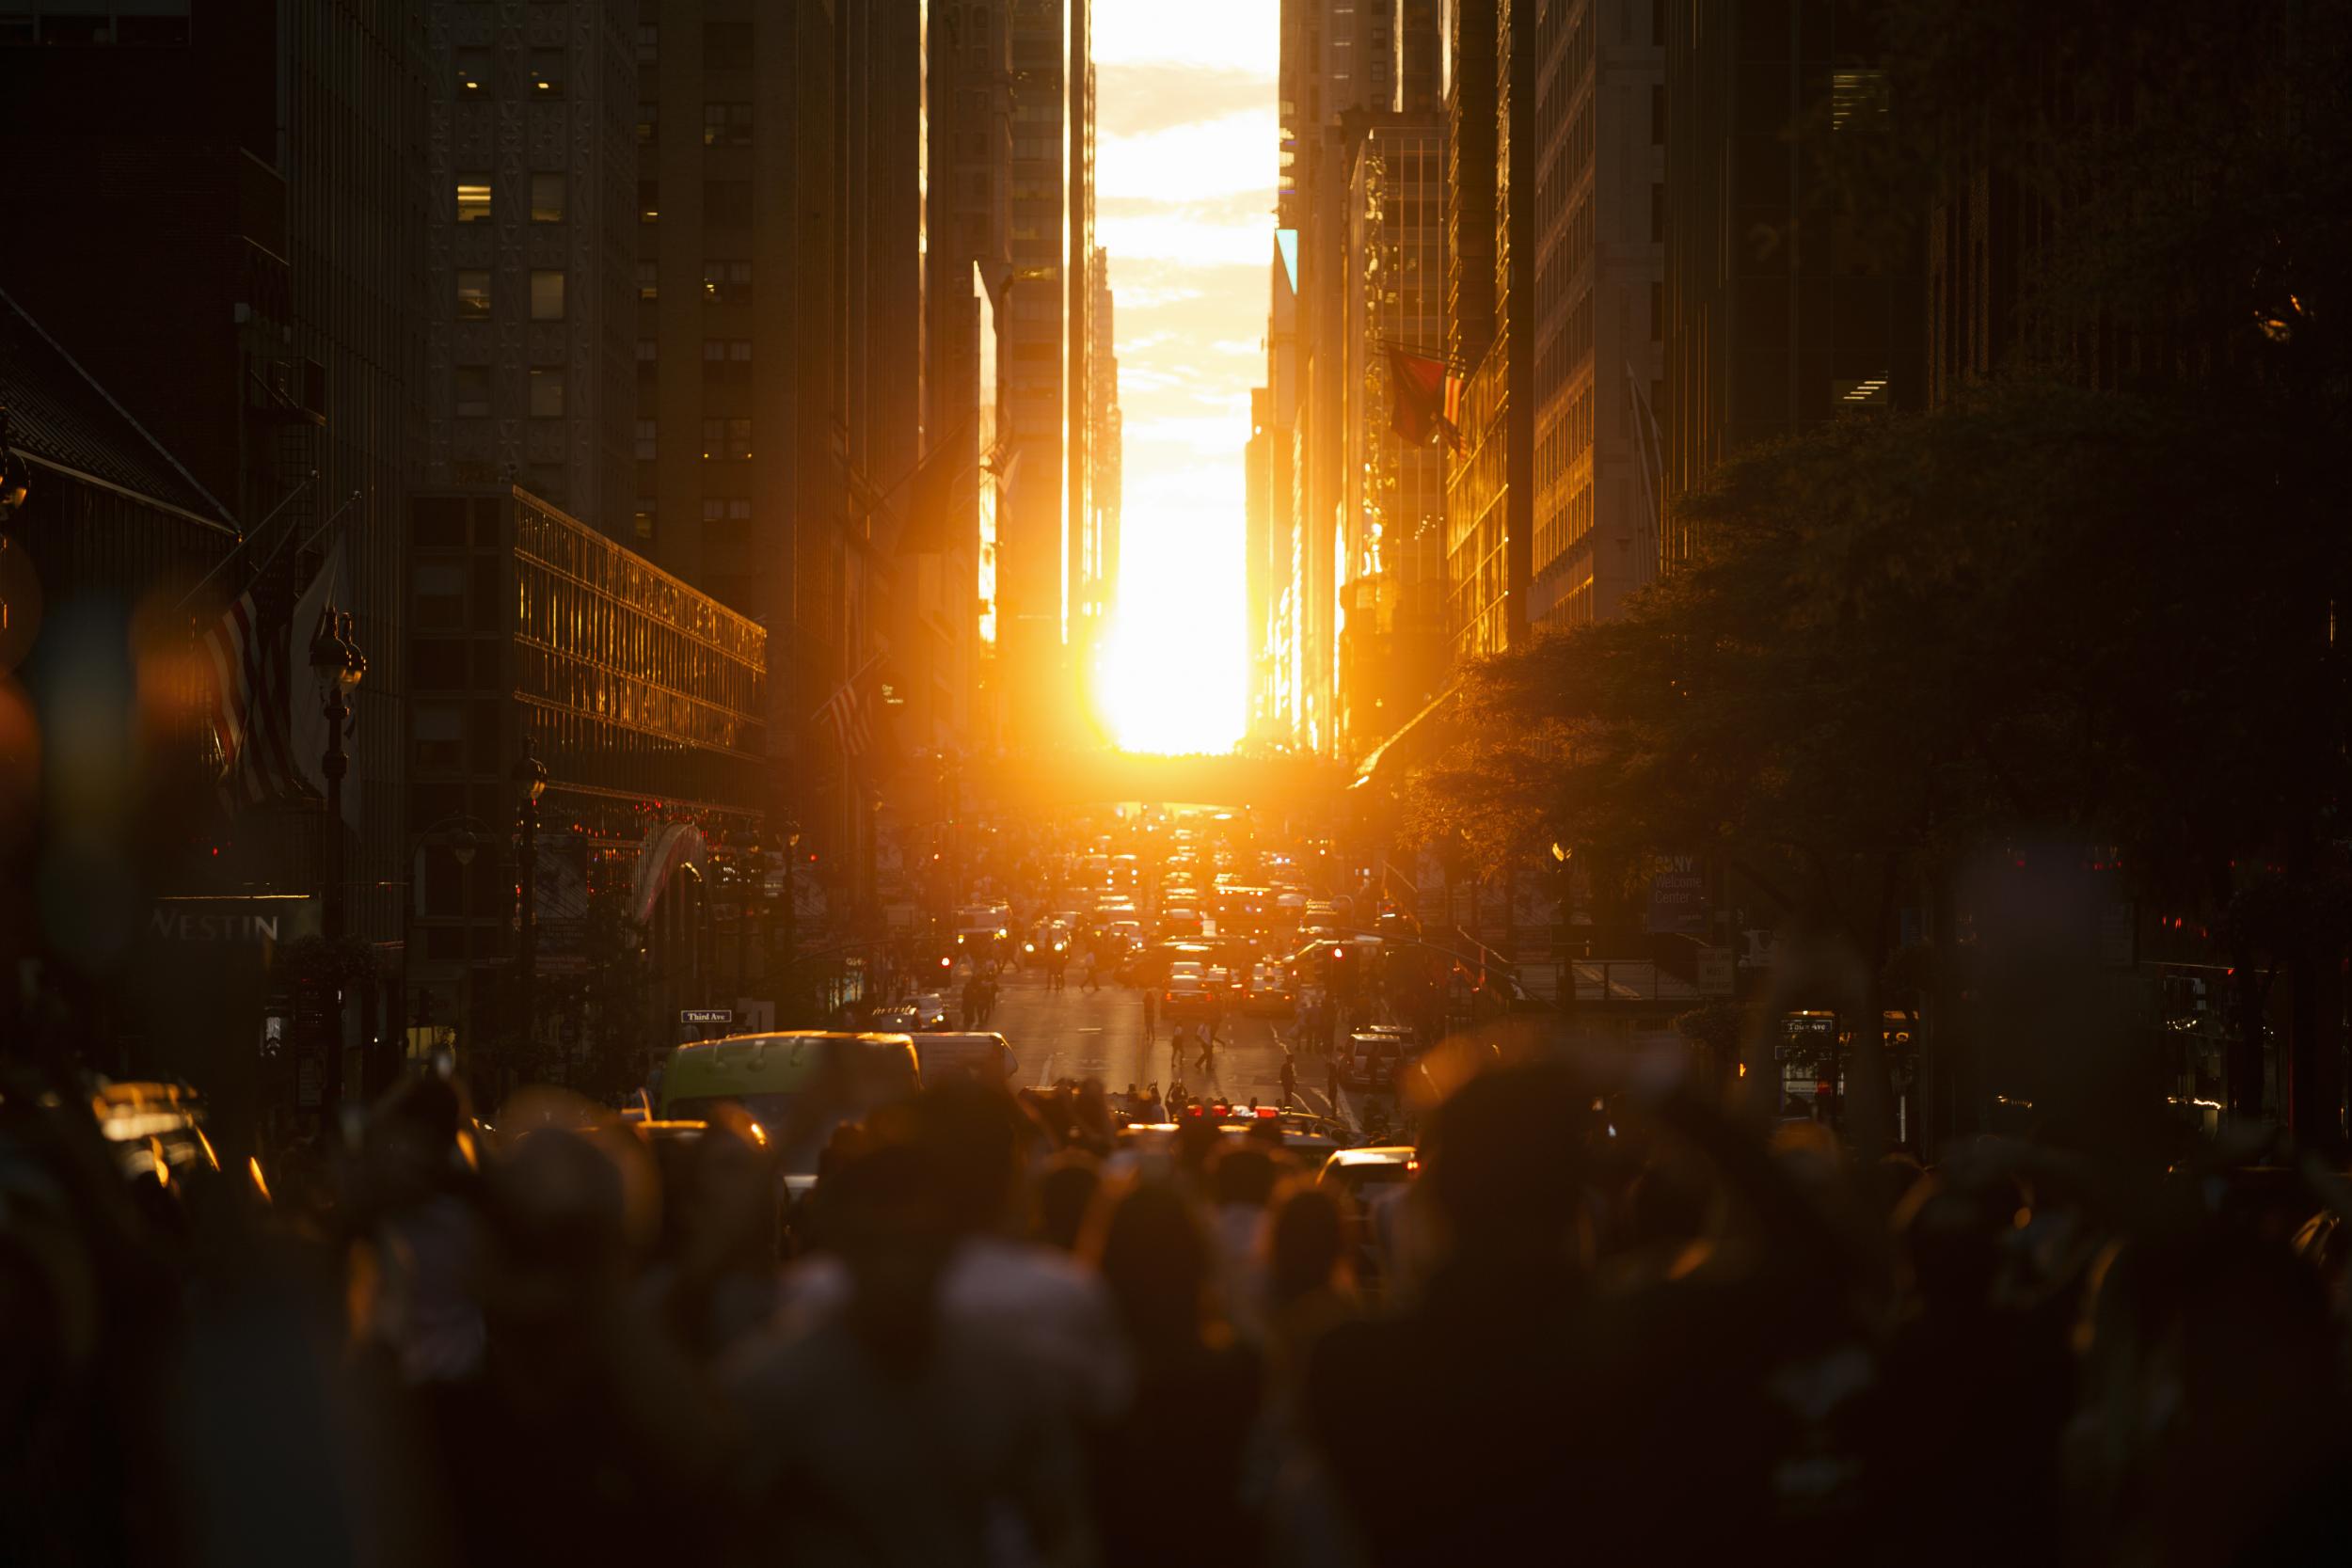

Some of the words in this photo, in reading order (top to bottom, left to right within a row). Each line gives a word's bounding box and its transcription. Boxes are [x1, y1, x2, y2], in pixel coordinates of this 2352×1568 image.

[1655, 874, 1702, 889] Welcome
[1655, 890, 1692, 904] Center
[150, 908, 278, 942] WESTIN
[687, 1012, 709, 1021] Third
[710, 1012, 725, 1021] Ave
